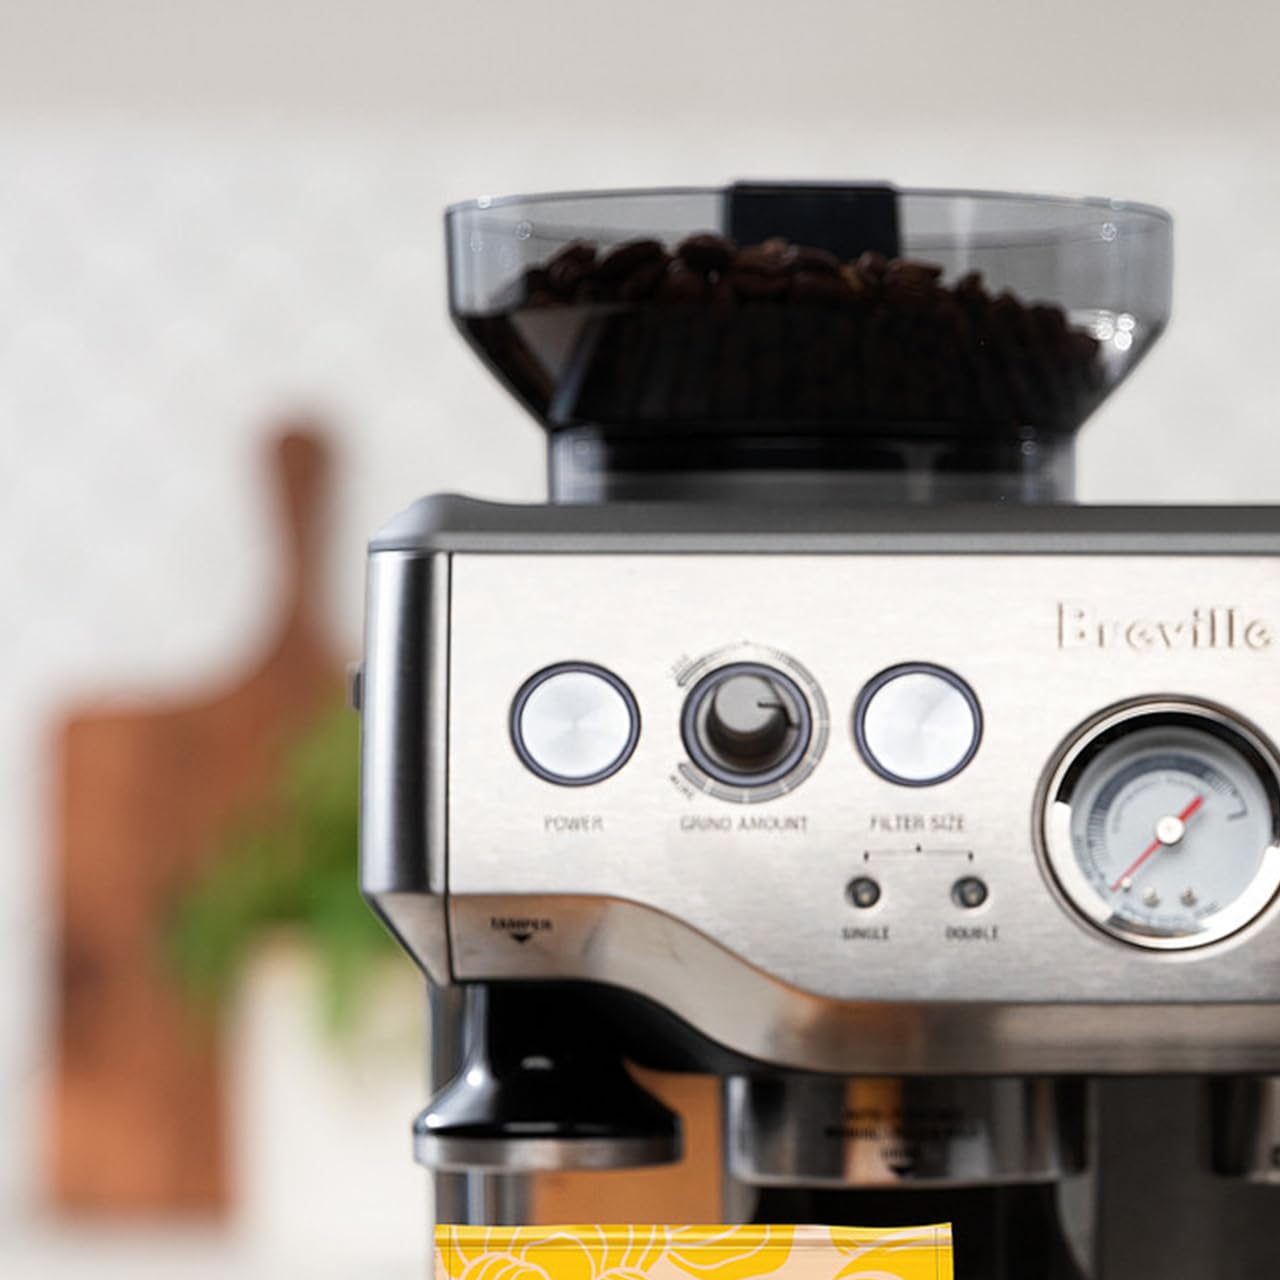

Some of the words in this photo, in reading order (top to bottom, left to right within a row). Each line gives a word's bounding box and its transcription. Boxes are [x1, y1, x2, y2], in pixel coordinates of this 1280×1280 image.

[1056, 600, 1275, 651] Breville
[544, 815, 605, 832] POWER
[679, 816, 732, 832] GRIND
[737, 816, 808, 832] AMOUNT
[870, 814, 925, 831] FILTER
[930, 814, 966, 831] SIZE
[945, 925, 999, 940] DOUBLE
